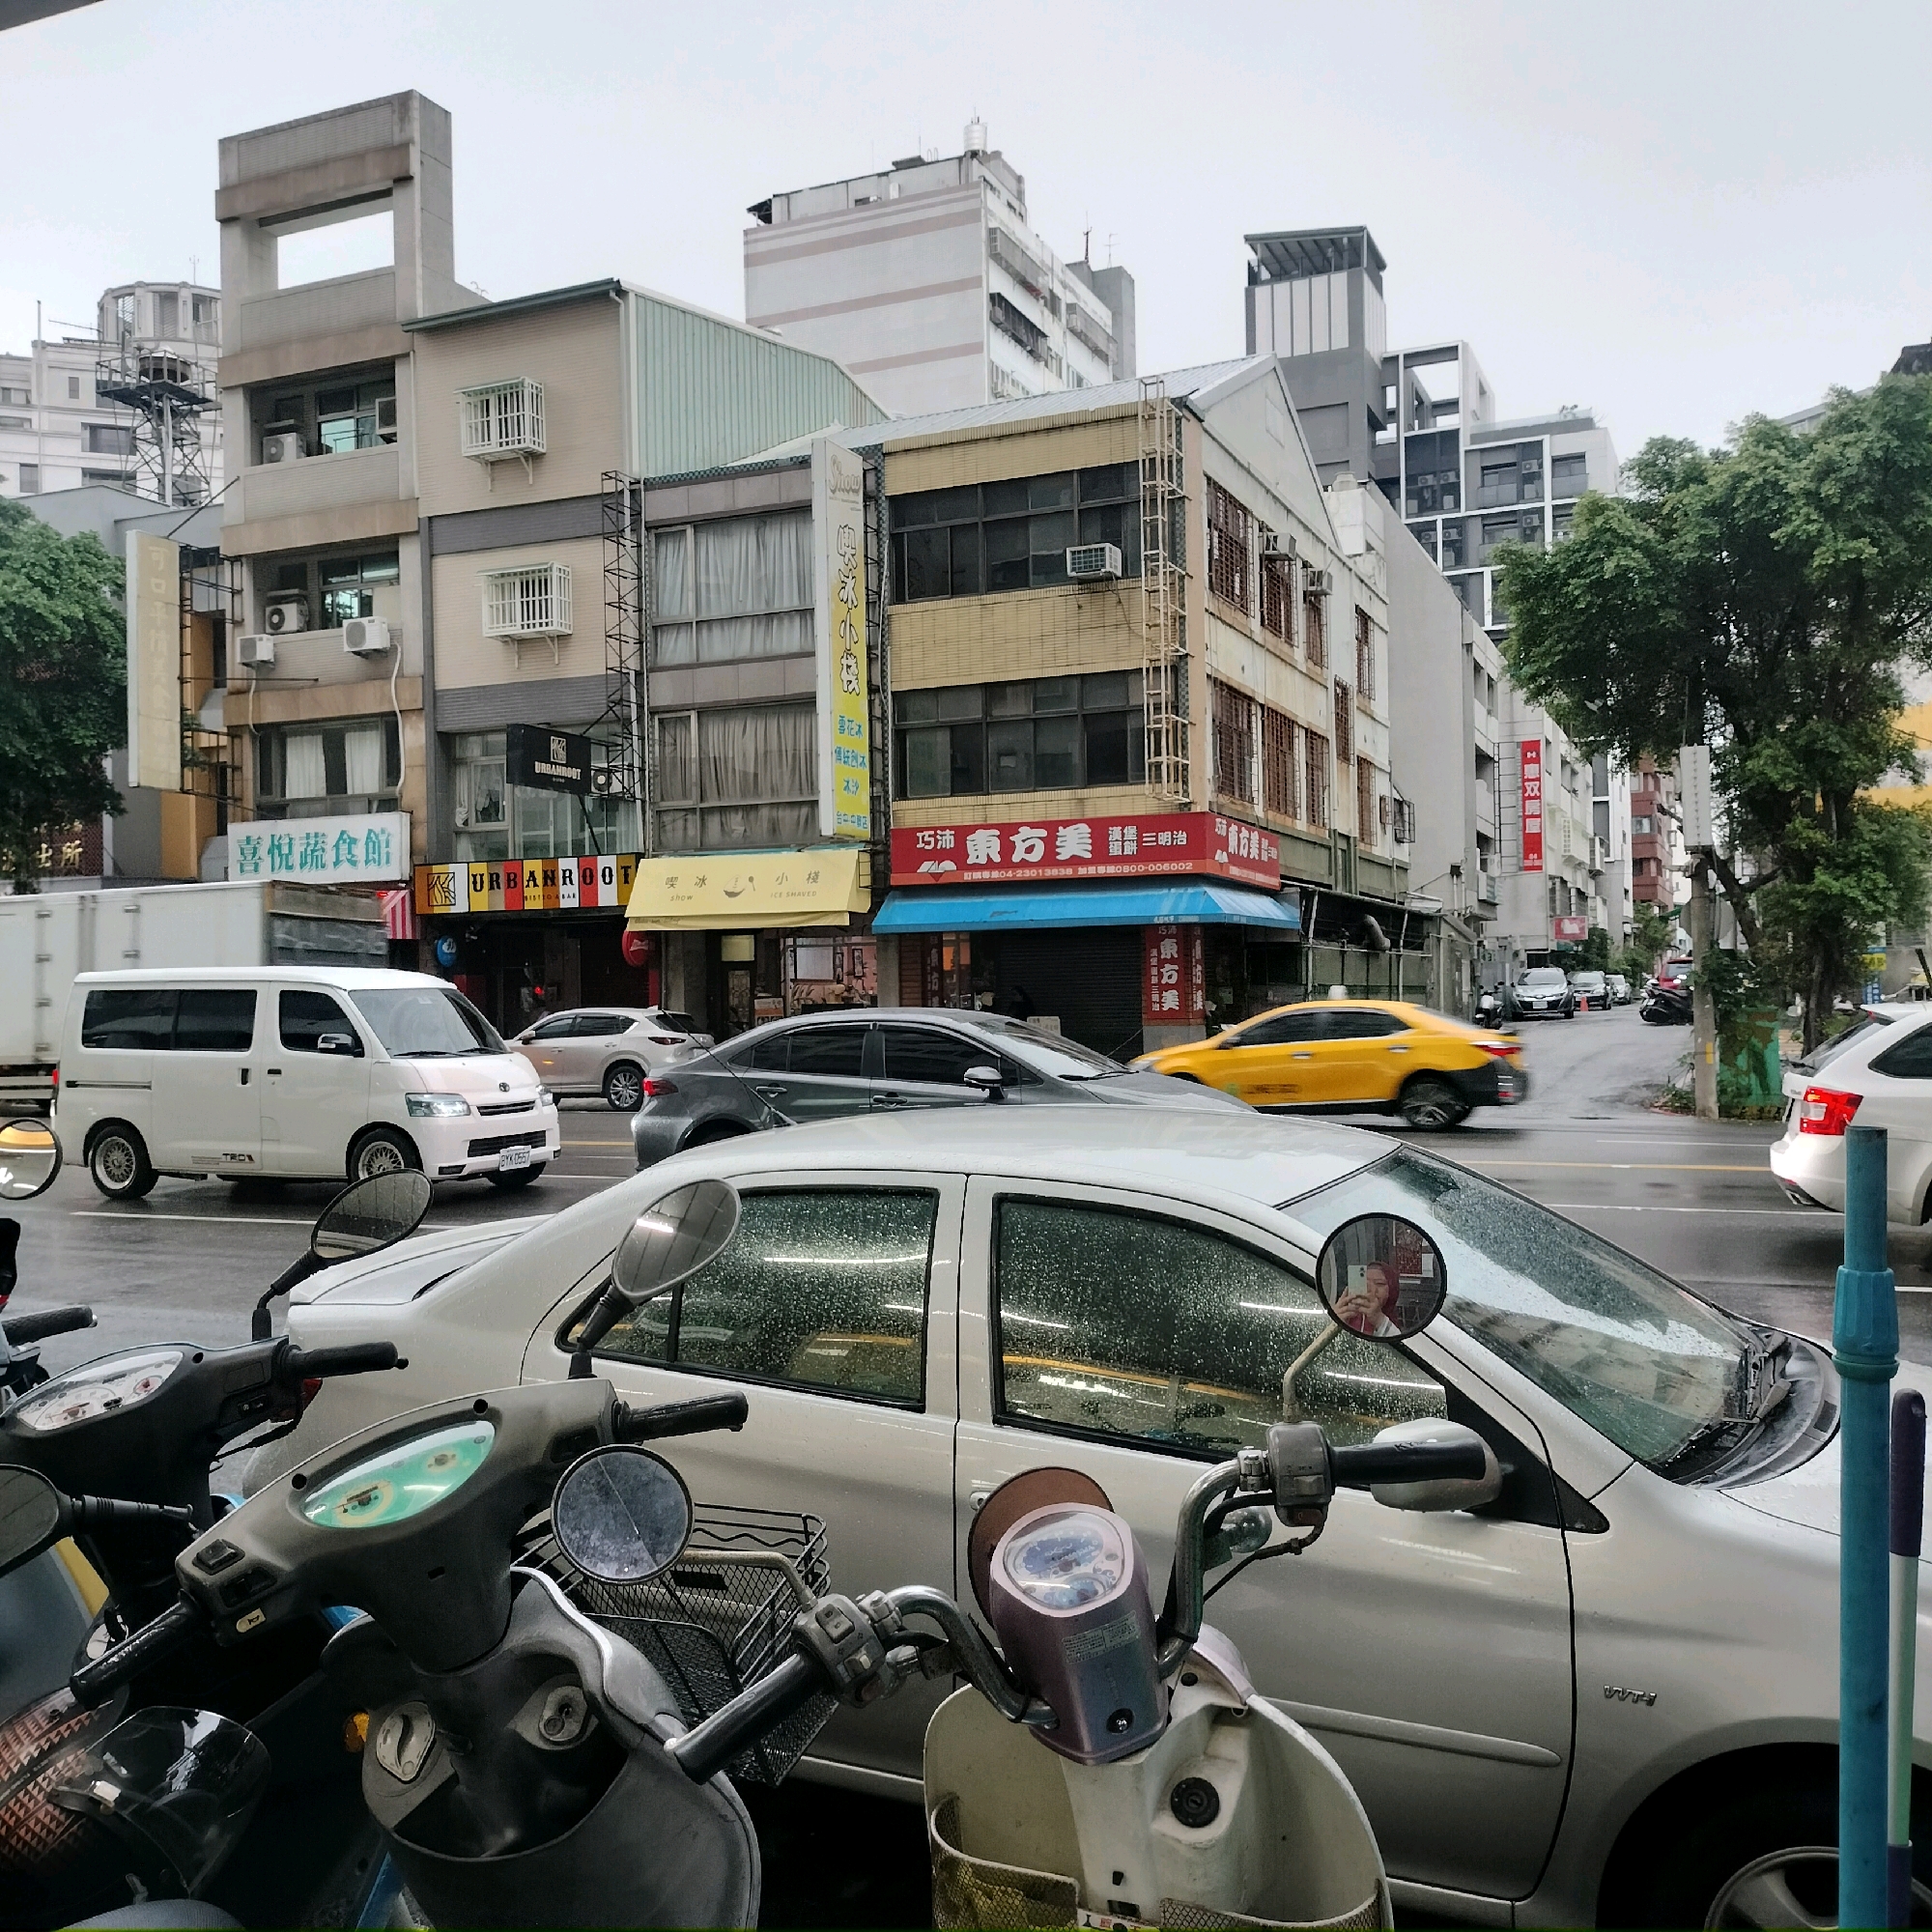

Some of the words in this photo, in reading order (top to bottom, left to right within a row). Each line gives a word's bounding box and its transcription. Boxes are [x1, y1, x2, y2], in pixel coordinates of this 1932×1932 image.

[534, 760, 582, 781] URBANROOT
[917, 829, 955, 850] 巧沛
[966, 822, 1093, 865] 東方美
[1142, 831, 1187, 846] 三明治
[470, 865, 633, 894] URBANROOT
[1160, 938, 1179, 1011] 東方美
